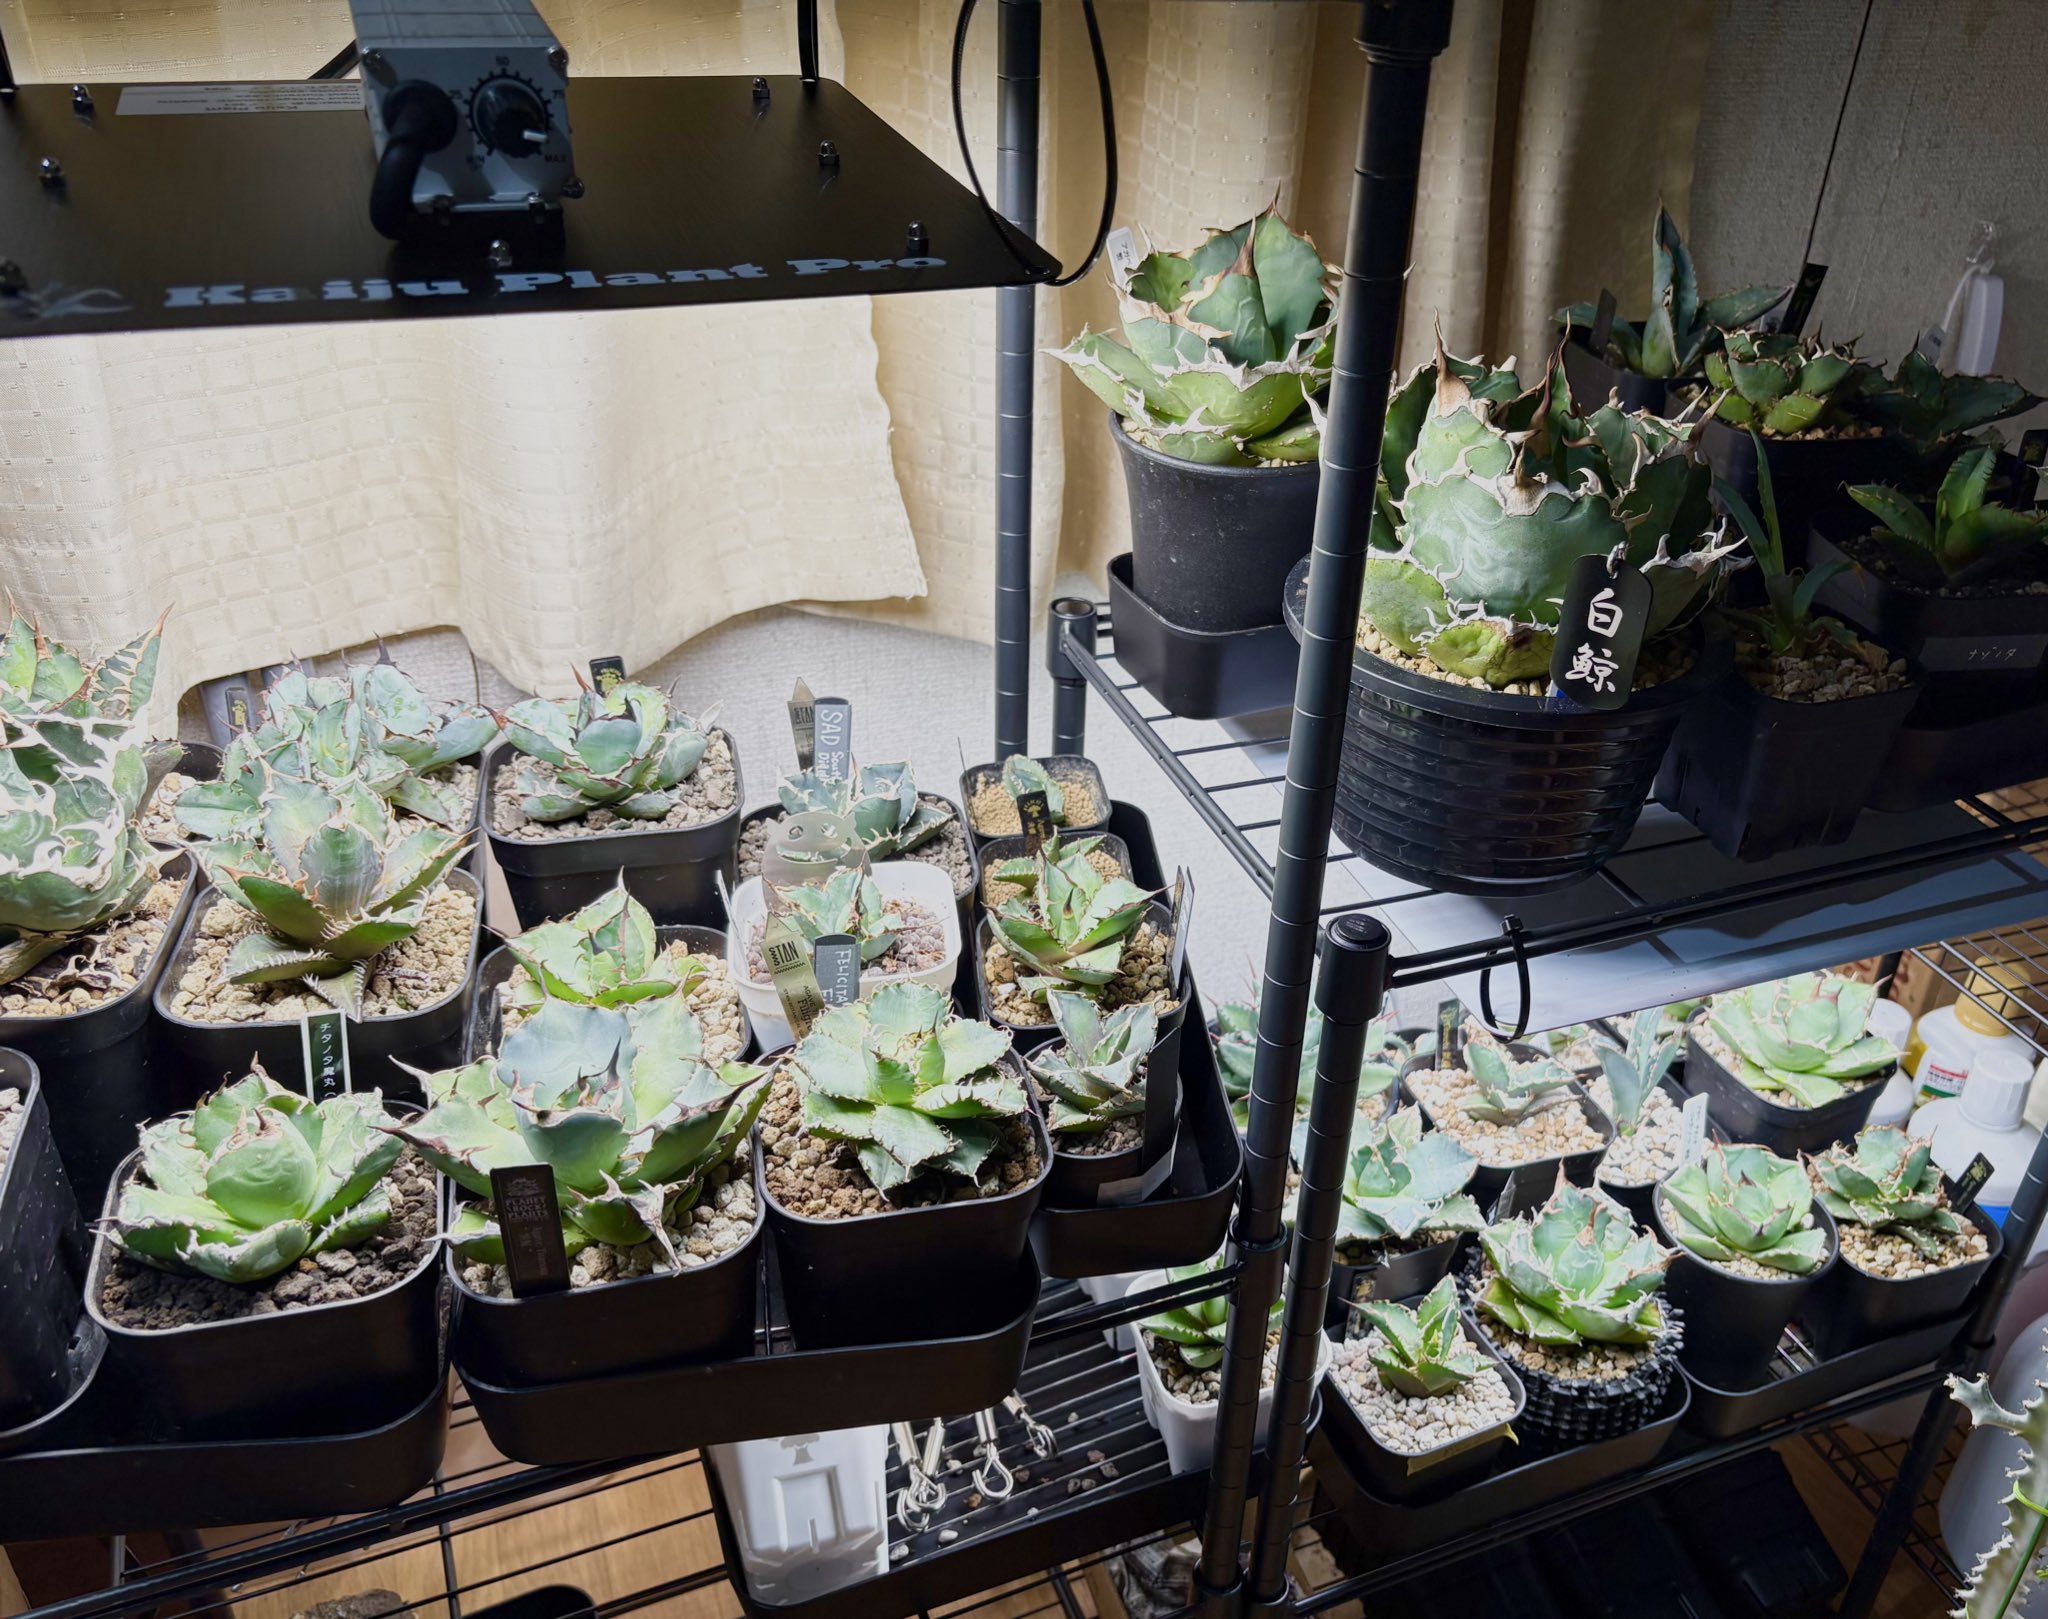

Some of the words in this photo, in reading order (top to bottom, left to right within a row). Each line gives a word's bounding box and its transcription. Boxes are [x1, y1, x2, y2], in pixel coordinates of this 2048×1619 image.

[544, 155, 567, 163] MAX
[164, 279, 468, 307] Kaiju
[495, 263, 768, 293] Plant
[786, 257, 946, 275] Pro
[1565, 588, 1623, 693] 白鯨
[820, 709, 843, 746] SAD
[769, 941, 799, 966] STAN
[834, 949, 852, 1004] FELICITA
[803, 985, 816, 1007] AGAVE
